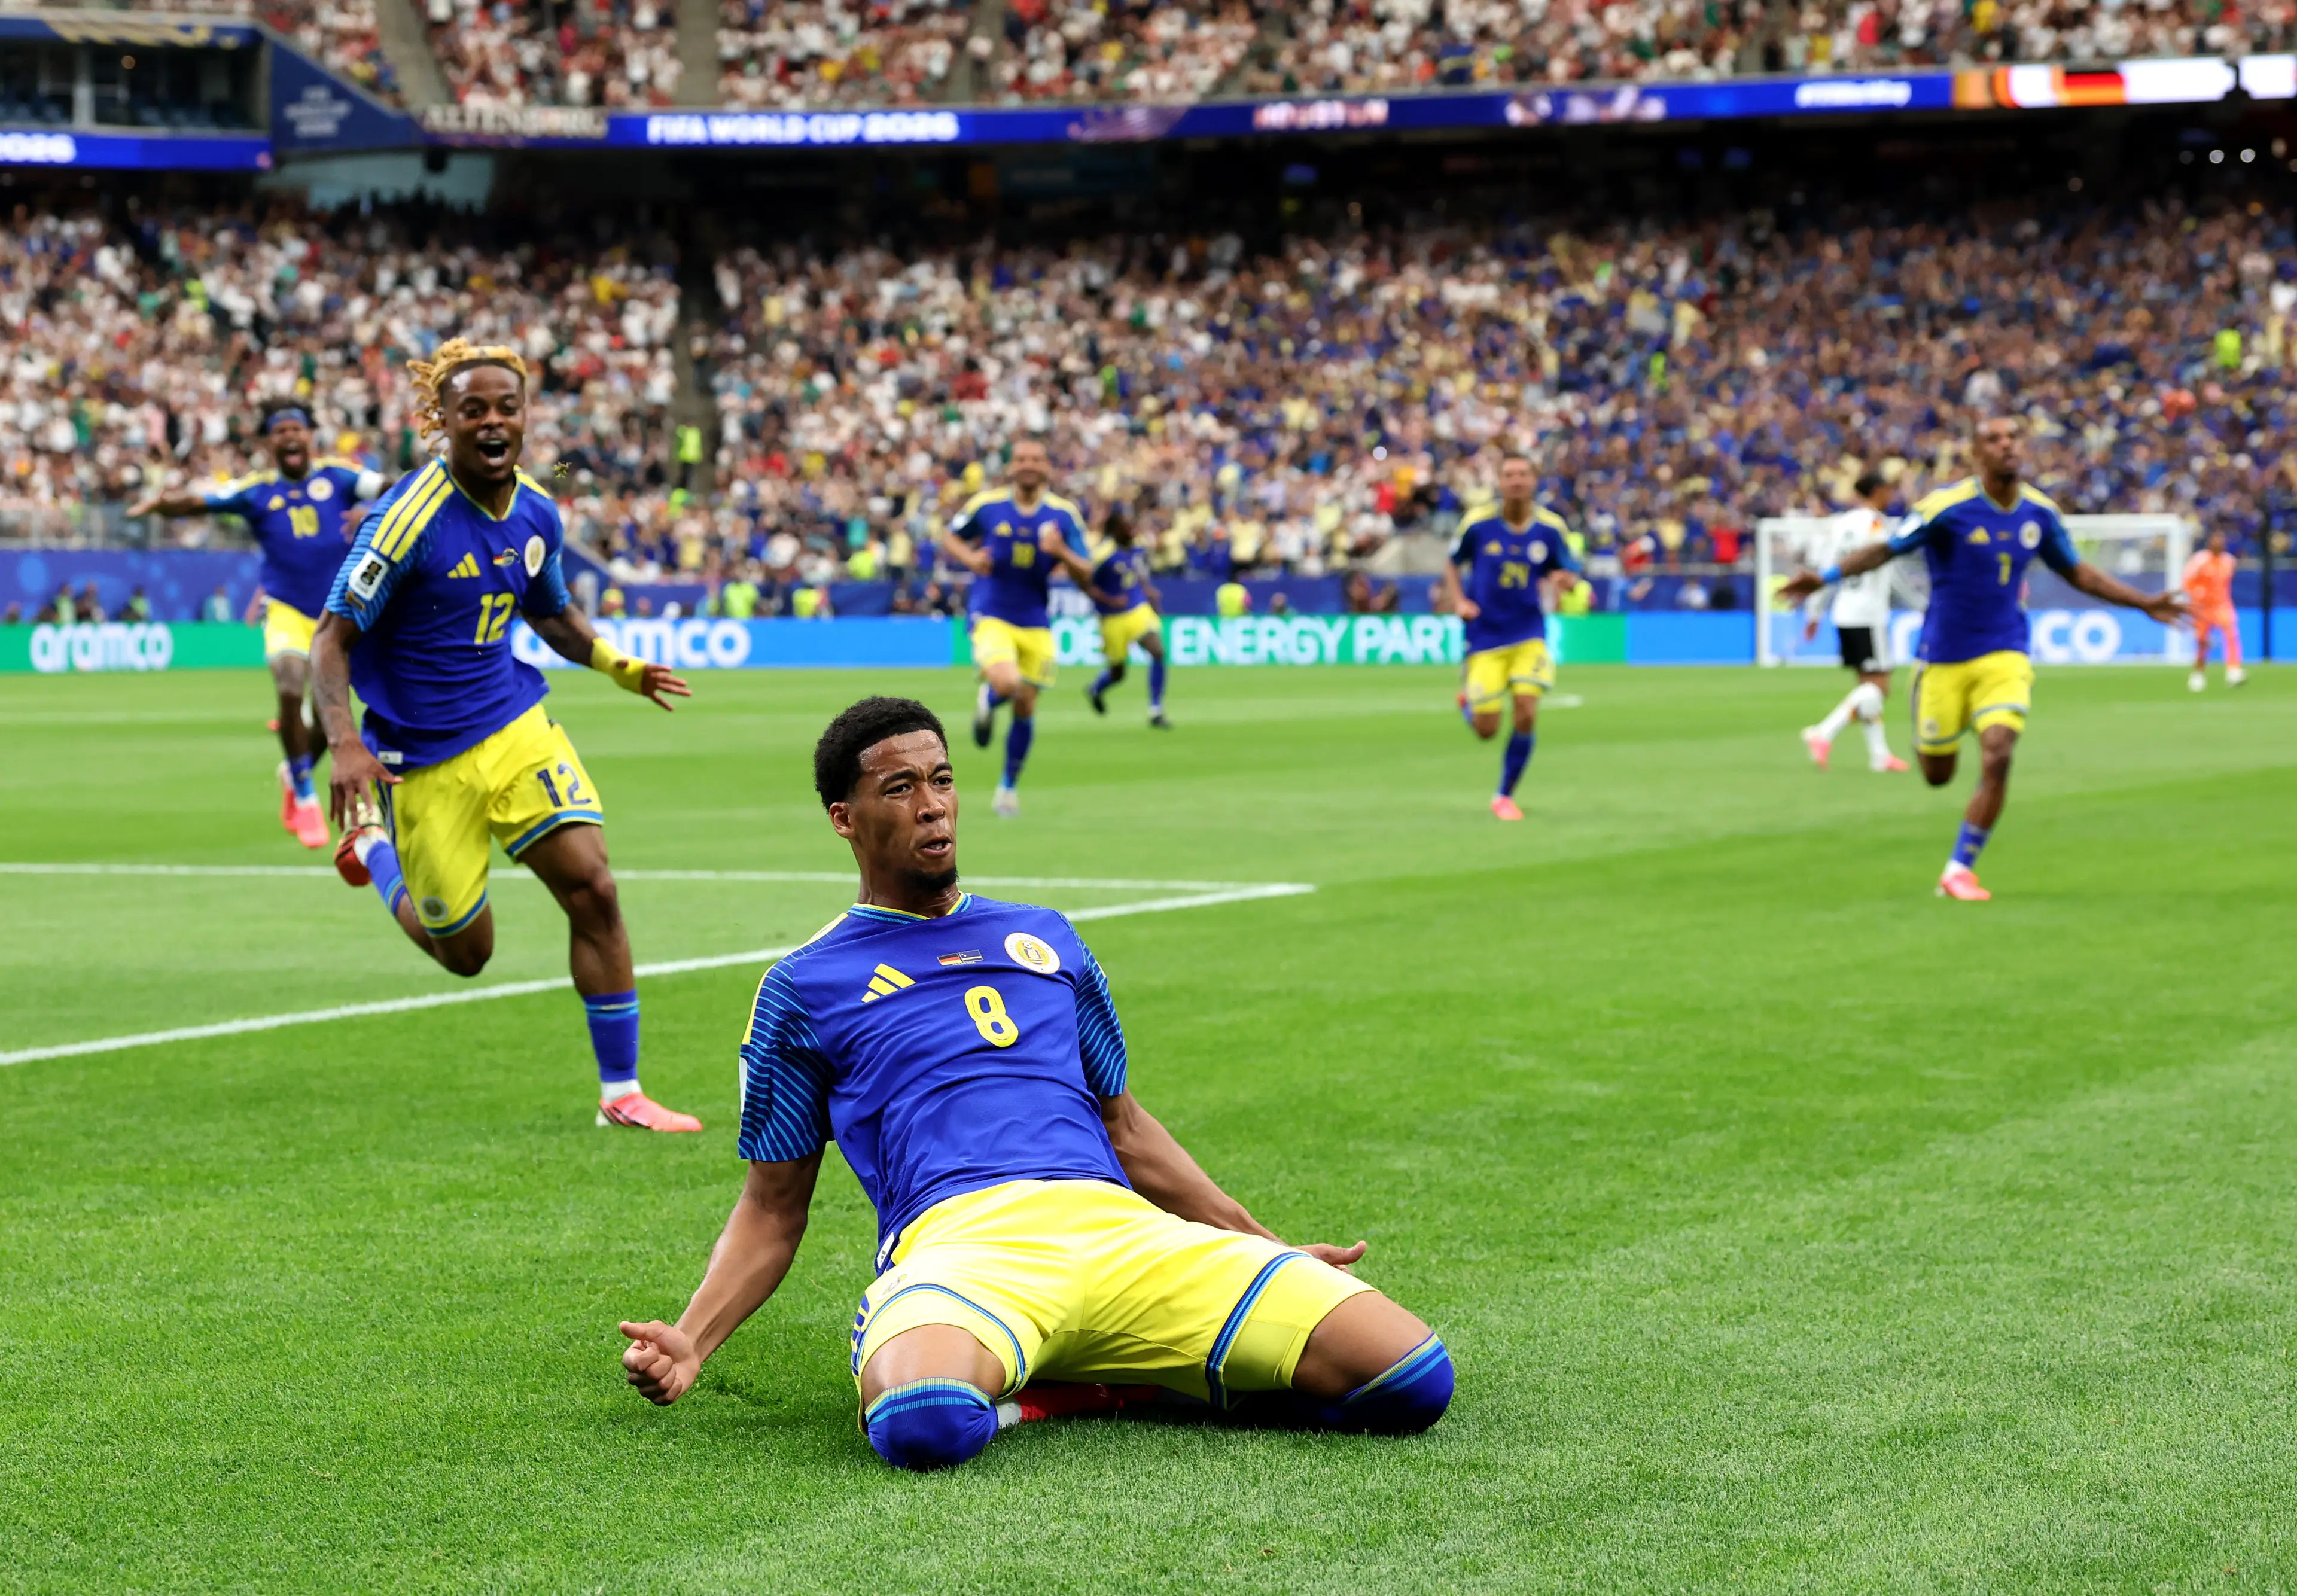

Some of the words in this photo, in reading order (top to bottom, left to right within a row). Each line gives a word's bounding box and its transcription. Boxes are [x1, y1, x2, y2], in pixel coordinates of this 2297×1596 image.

[647, 115, 708, 144] FIFA
[709, 115, 806, 144] WORLD
[808, 114, 861, 144] CUP
[287, 504, 319, 538] 10
[474, 592, 515, 645] 12
[1171, 616, 1348, 666] ENERGY
[30, 623, 173, 672] aramco
[537, 763, 592, 808] 12
[964, 986, 1019, 1047] 8
